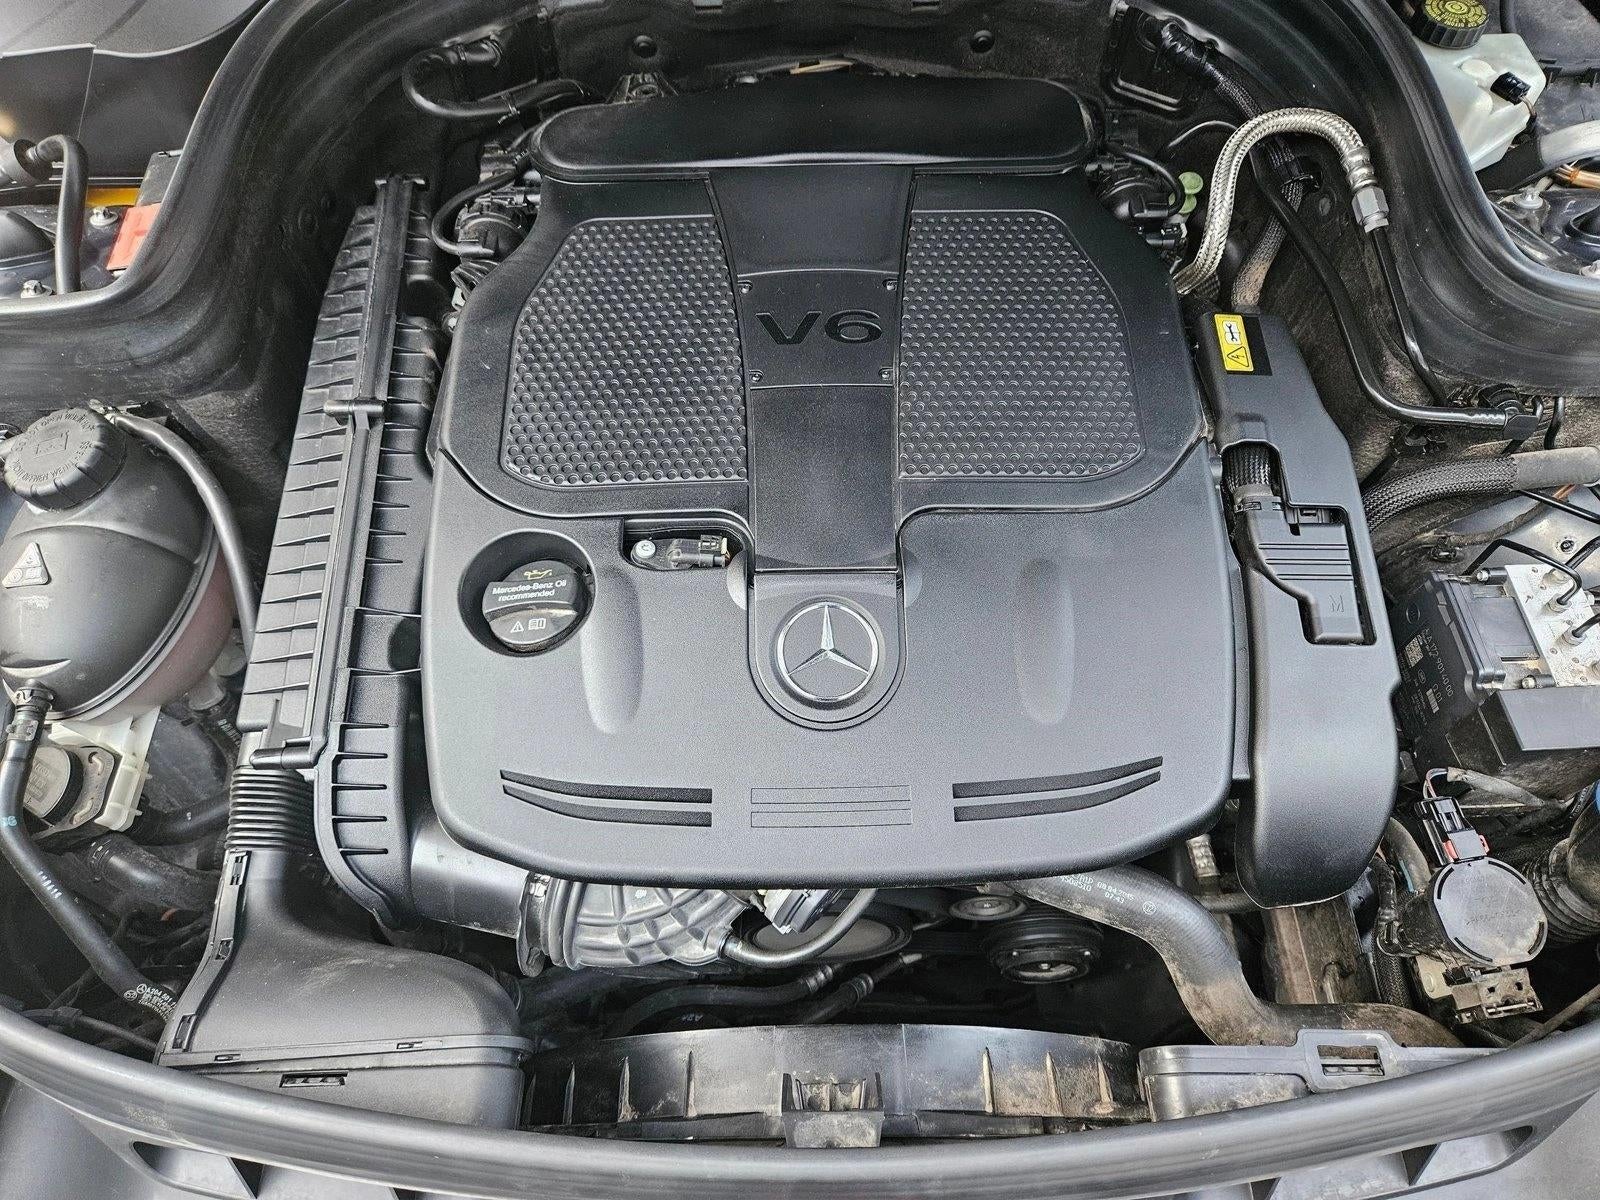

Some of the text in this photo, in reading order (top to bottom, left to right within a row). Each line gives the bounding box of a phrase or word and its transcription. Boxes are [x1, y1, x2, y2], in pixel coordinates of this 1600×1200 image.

[755, 309, 882, 345] V6
[492, 579, 567, 595] Mercedes-Benz Oil
[498, 589, 555, 601] recommended
